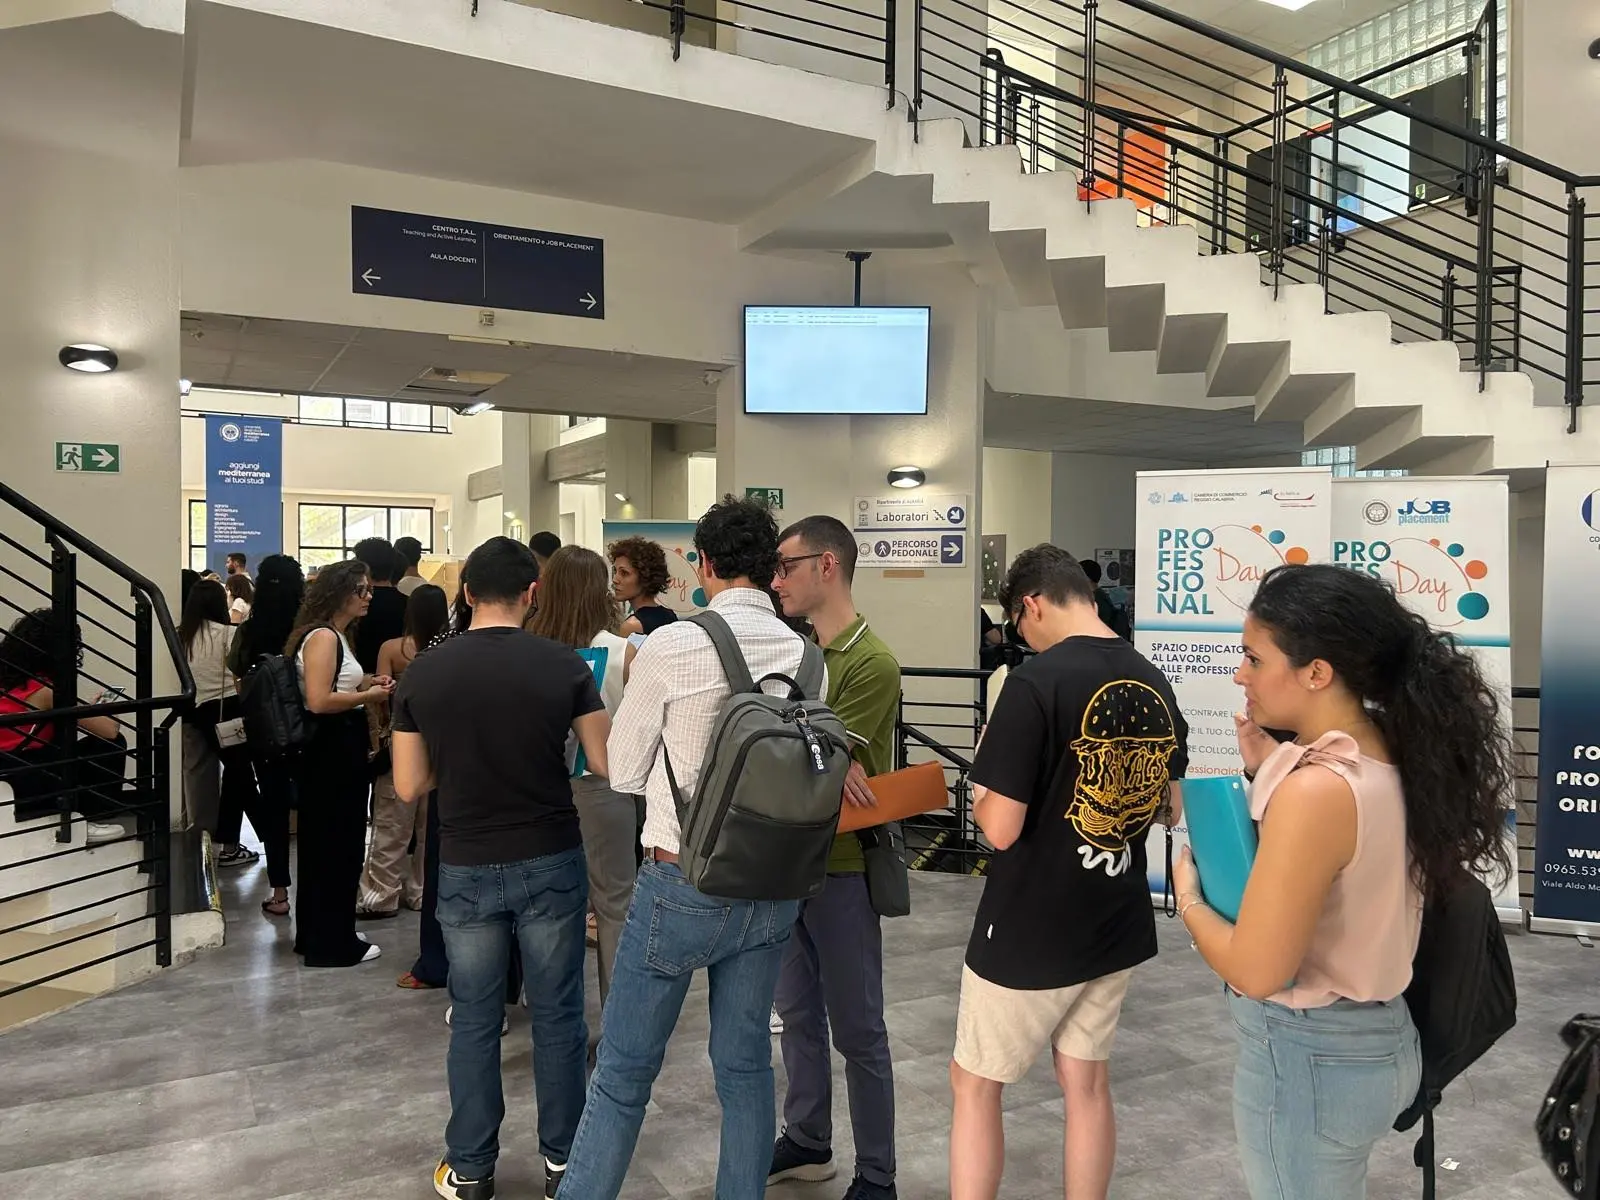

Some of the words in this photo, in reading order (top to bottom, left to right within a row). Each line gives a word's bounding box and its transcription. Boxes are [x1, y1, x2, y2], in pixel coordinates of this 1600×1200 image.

[402, 228, 426, 238] Teaching
[432, 224, 458, 232] CENTRO
[493, 232, 540, 244] ORIENTAMENTO
[558, 242, 594, 252] PLACEMENT
[430, 252, 448, 260] AULA
[448, 256, 476, 264] DOCENTI
[229, 462, 260, 470] aggiungi
[218, 470, 270, 478] mediterranea
[1398, 497, 1450, 515] JOB
[876, 512, 928, 522] Laboratori
[1398, 513, 1450, 526] placement
[1158, 528, 1214, 549] PRO
[1334, 541, 1391, 562] PRO
[1157, 550, 1204, 570] FES
[1157, 572, 1204, 592] SIO
[1390, 560, 1452, 612] Day
[1157, 594, 1214, 614] NAL
[1152, 643, 1188, 652] SPAZIO
[1191, 644, 1244, 654] DEDICATO
[1167, 654, 1210, 664] LAVORO
[1186, 666, 1240, 674] PROFESSIO
[1180, 708, 1228, 718] NCONTRARE
[1206, 728, 1222, 736] TUO
[1198, 746, 1240, 756] COLLOQU
[1574, 745, 1600, 760] FO
[1556, 772, 1600, 786] PRO
[1558, 798, 1600, 813] ORI
